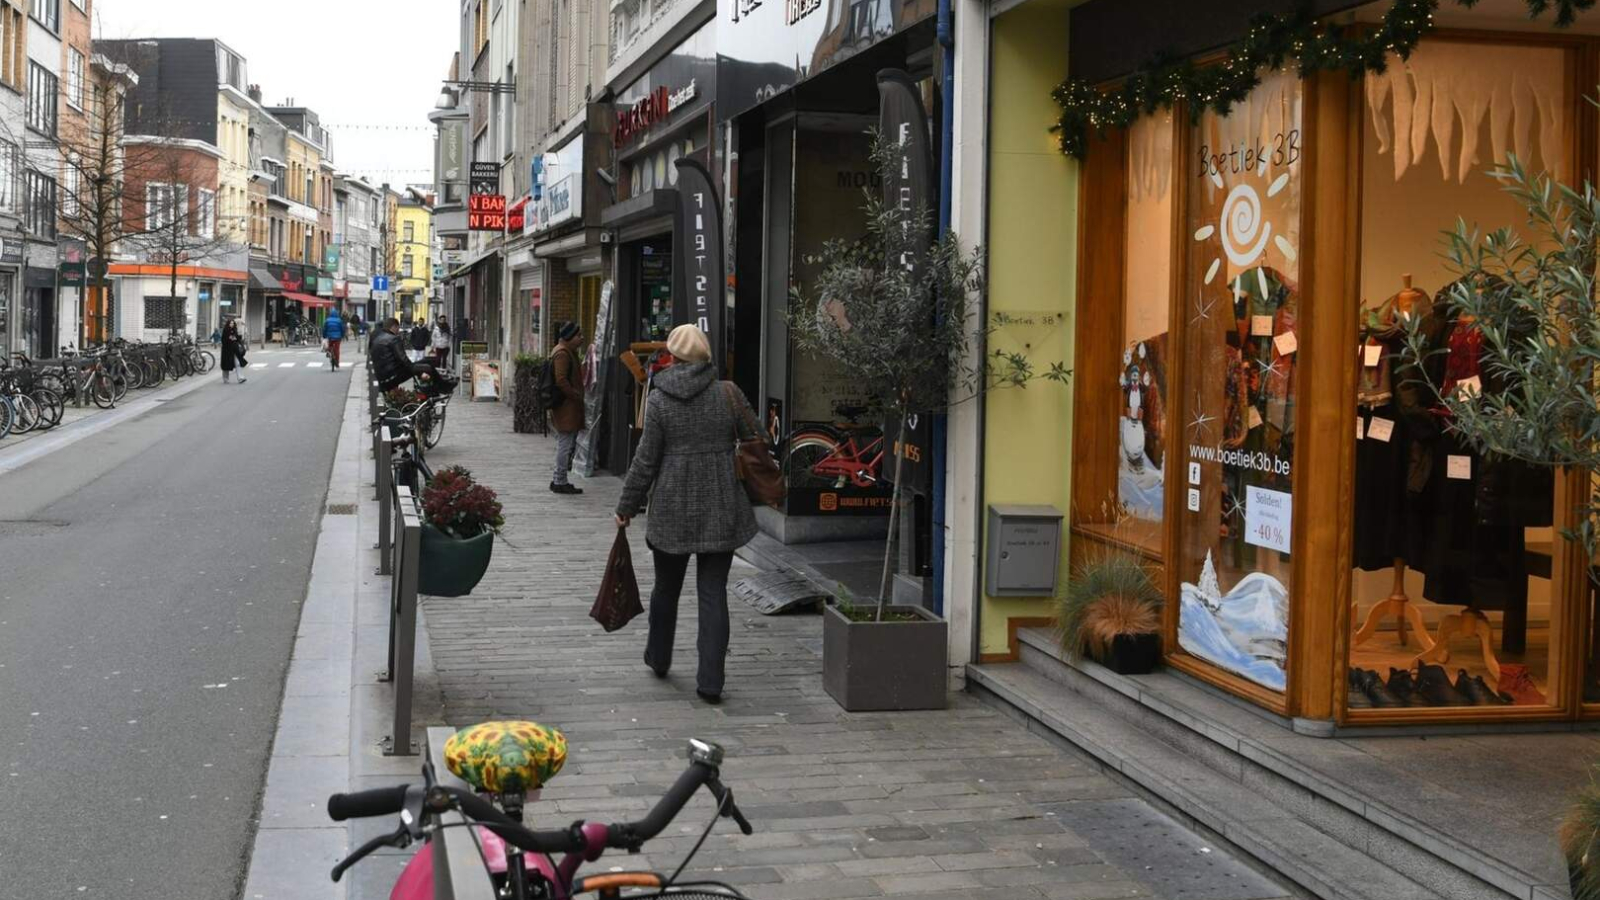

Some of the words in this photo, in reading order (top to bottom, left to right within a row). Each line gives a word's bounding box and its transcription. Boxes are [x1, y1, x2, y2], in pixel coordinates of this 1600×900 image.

[1197, 137, 1266, 178] Boetiek
[1272, 129, 1300, 167] 3B
[470, 214, 480, 227] N
[483, 214, 505, 228] PIK
[1189, 444, 1291, 476] www.boetiek3b.be
[1255, 491, 1283, 510] Solden!
